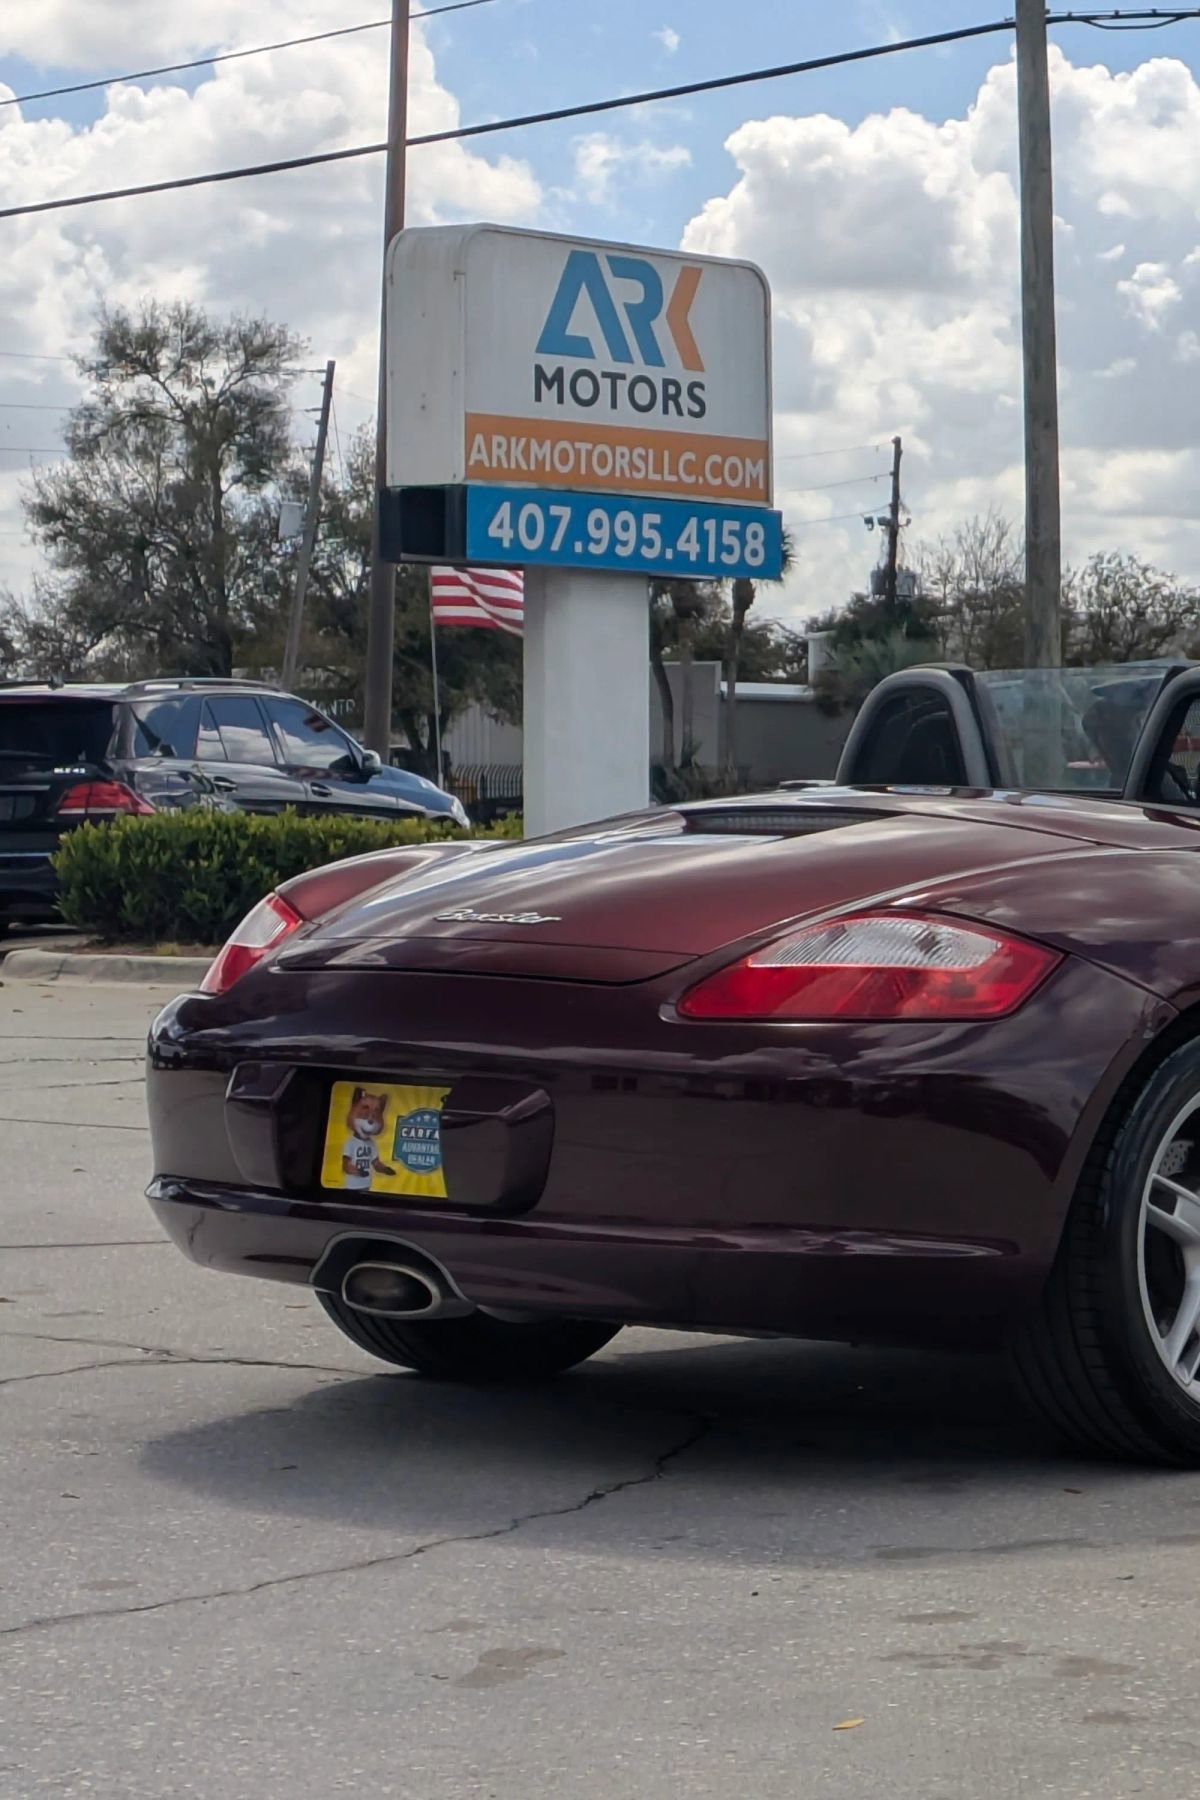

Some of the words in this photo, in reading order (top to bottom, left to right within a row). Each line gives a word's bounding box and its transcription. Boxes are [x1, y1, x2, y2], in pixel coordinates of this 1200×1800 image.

[535, 249, 705, 372] ARK
[534, 363, 706, 419] MOTORS
[469, 432, 764, 490] ARKMOTORSLLC.COM
[488, 501, 766, 567] 407.995.4158
[433, 908, 562, 923] Boxster
[356, 1145, 372, 1158] CAR
